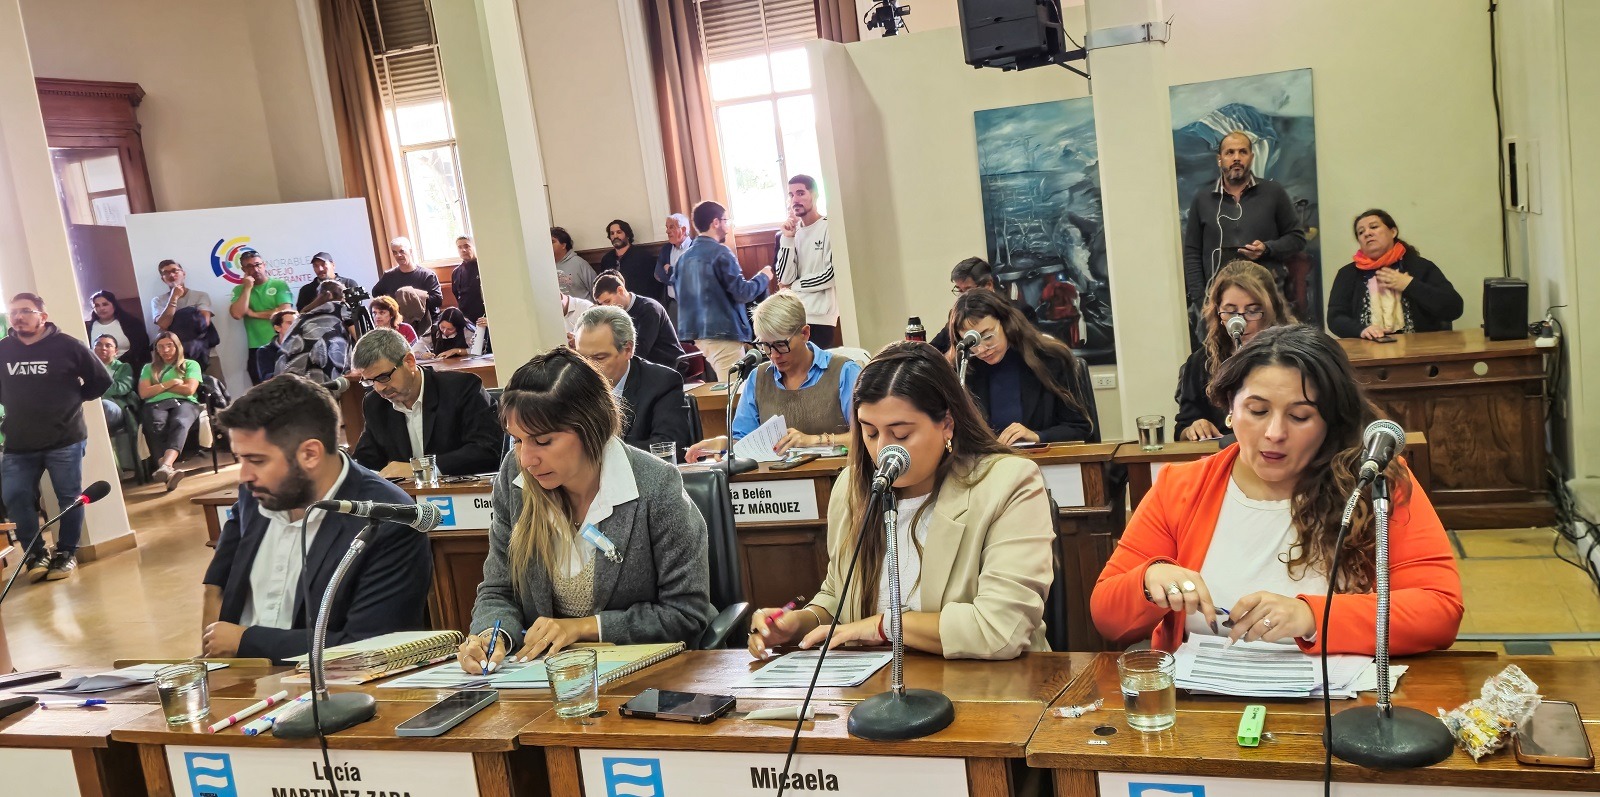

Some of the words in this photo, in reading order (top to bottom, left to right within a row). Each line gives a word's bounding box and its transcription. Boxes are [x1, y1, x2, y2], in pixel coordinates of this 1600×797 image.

[264, 267, 293, 276] NCEJO
[6, 361, 49, 375] VANS
[729, 489, 739, 499] ía
[742, 488, 772, 499] Belén
[732, 504, 746, 515] EZ
[748, 501, 800, 514] MÁRQUEZ
[312, 761, 362, 781] Lucía
[750, 767, 839, 791] Micaela
